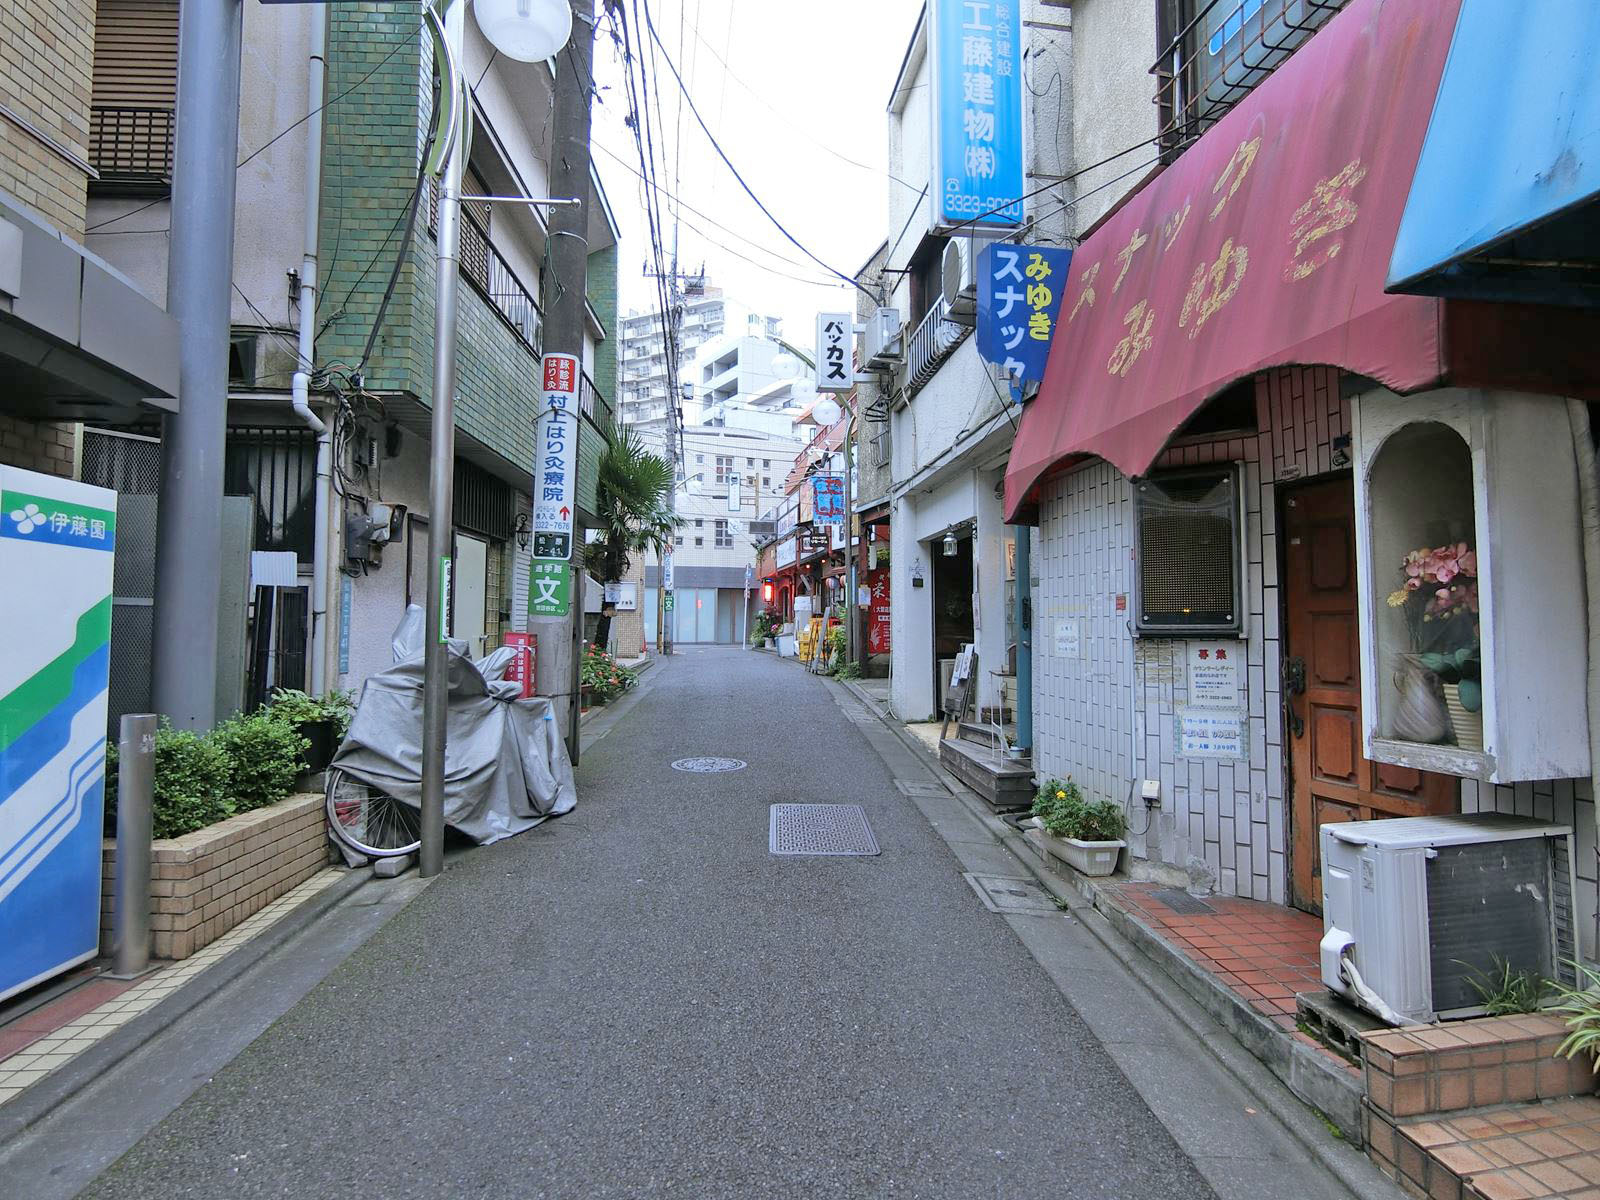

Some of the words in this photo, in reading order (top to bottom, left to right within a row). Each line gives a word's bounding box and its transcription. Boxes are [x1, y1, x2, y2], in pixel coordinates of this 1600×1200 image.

[995, 3, 1013, 78] 総合建設
[1025, 253, 1052, 341] みゆき
[1107, 156, 1367, 379] みゆき
[823, 320, 848, 382] バッカス
[542, 394, 568, 502] 村上はり灸療院
[49, 511, 106, 541] 伊藤園
[533, 575, 561, 605] 文
[1198, 648, 1227, 660] 募集
